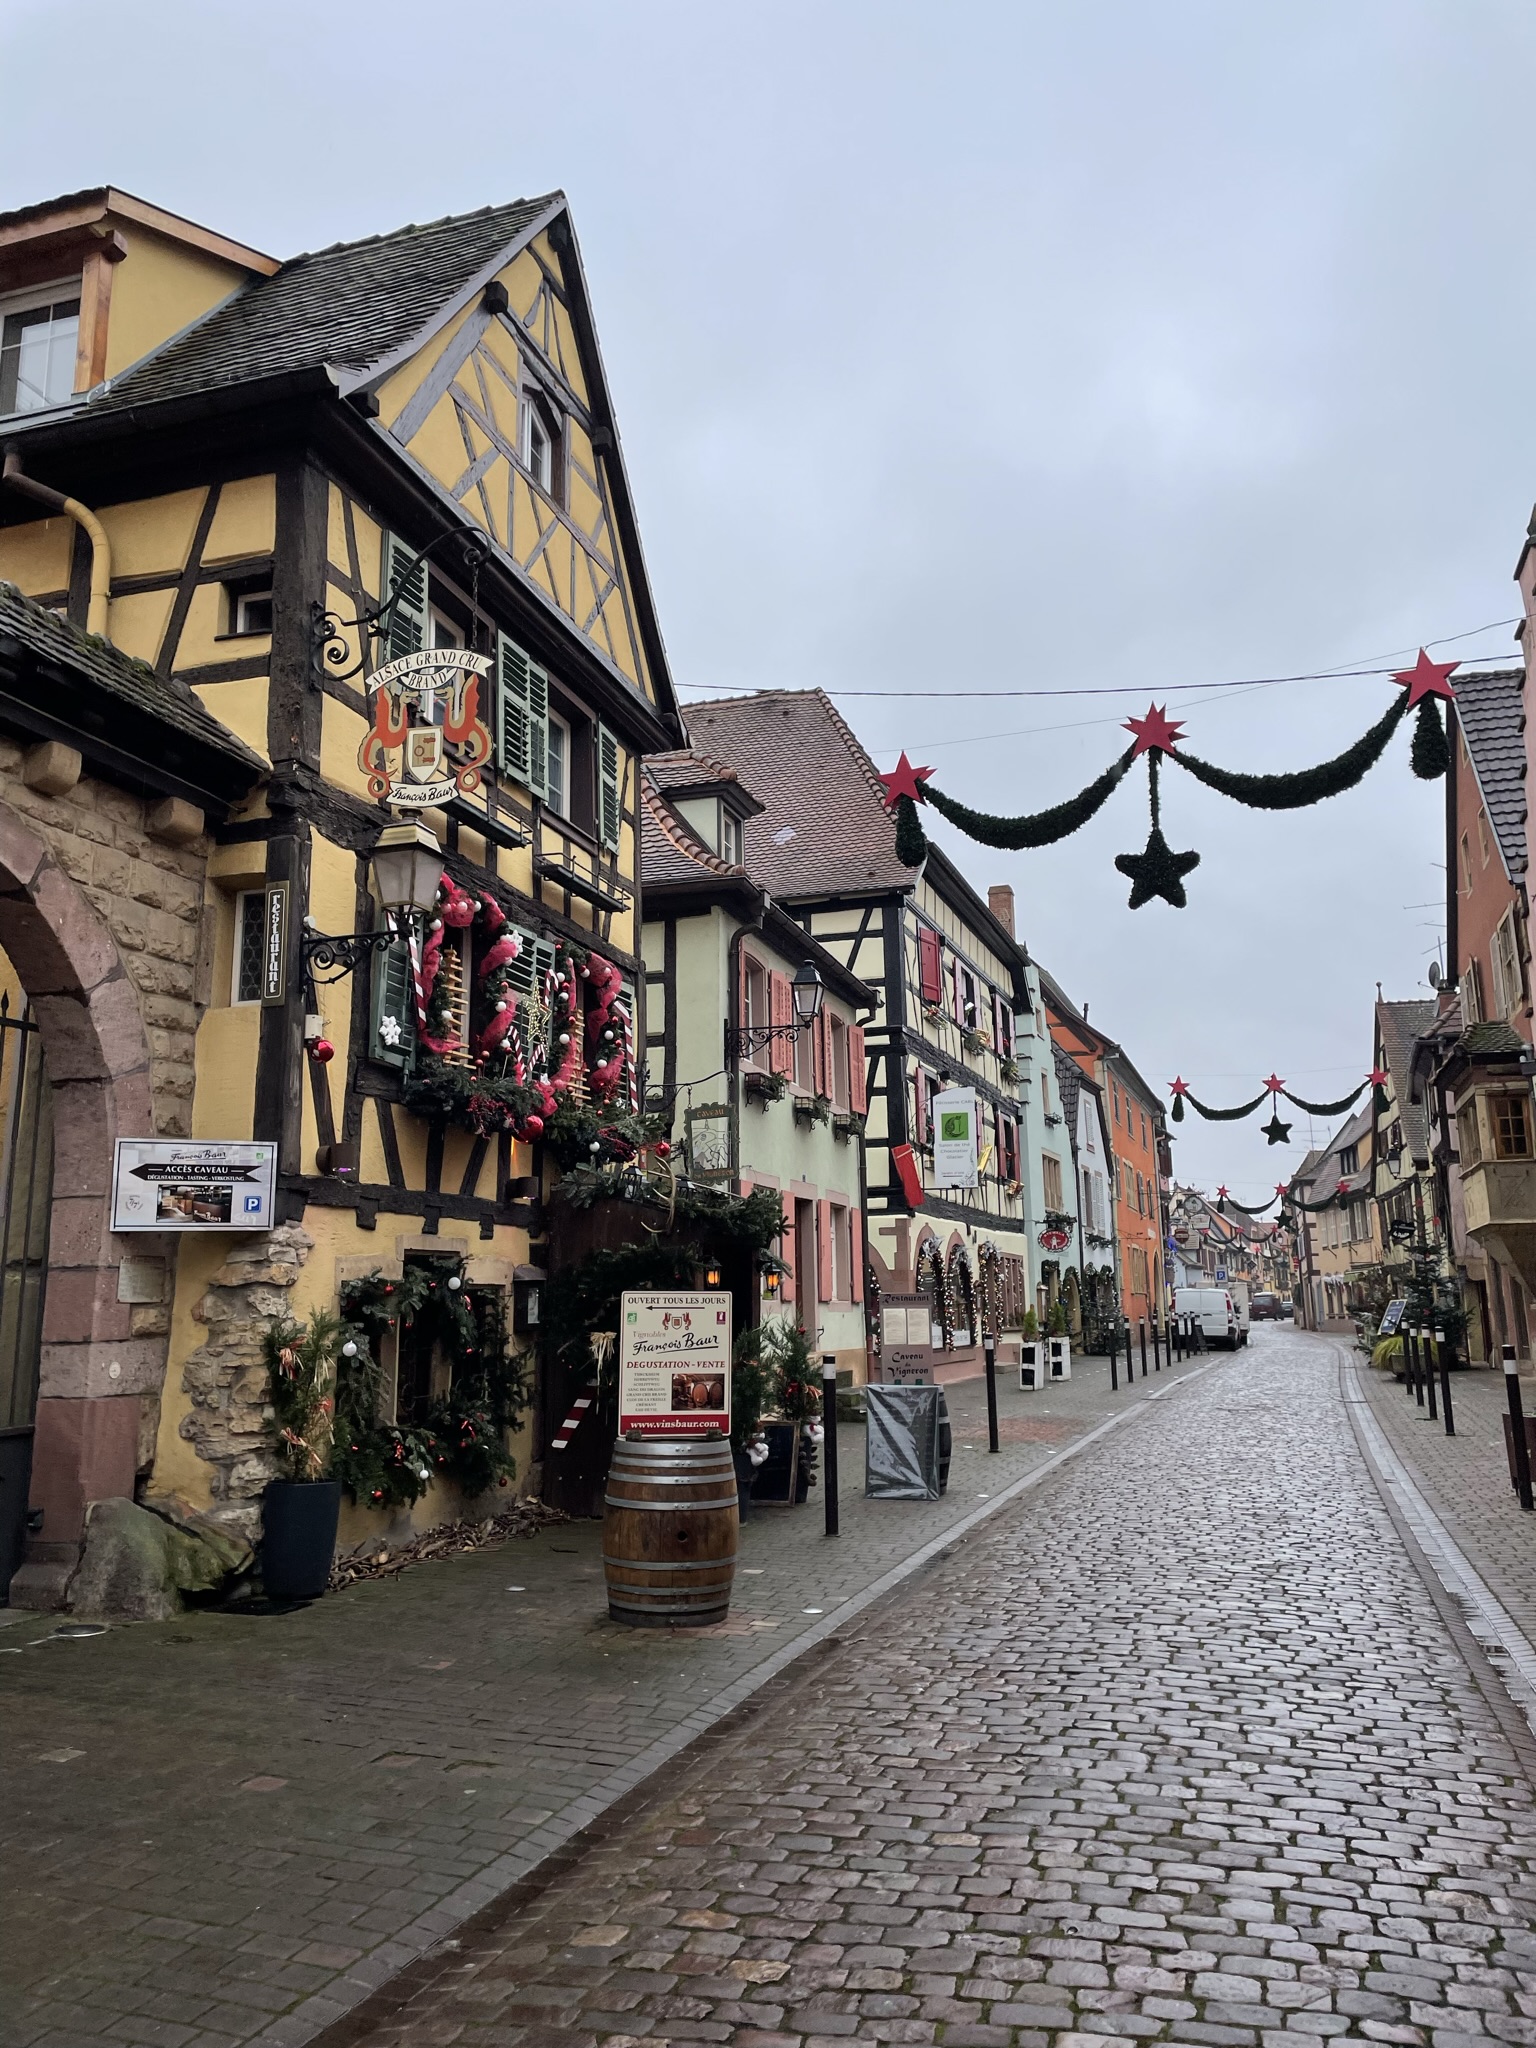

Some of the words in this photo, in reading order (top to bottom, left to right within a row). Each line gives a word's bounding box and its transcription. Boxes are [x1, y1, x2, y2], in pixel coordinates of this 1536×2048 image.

[372, 656, 413, 686] ALSACE
[416, 651, 456, 666] GRAND
[459, 652, 483, 670] CRU
[408, 671, 447, 688] BRAND
[392, 787, 427, 803] François
[427, 786, 454, 801] Baur
[165, 1164, 192, 1173] ACCÈS
[194, 1166, 229, 1174] CAVEAU
[627, 1296, 661, 1304] OUVERT
[882, 1294, 930, 1304] Restaurant
[632, 1340, 682, 1356] François
[682, 1332, 720, 1348] Baur
[891, 1352, 924, 1363] Caveau
[626, 1361, 690, 1369] DEGUSTATION
[887, 1367, 929, 1378] Vigneron
[630, 1419, 720, 1429] www.vinsbaur.com
